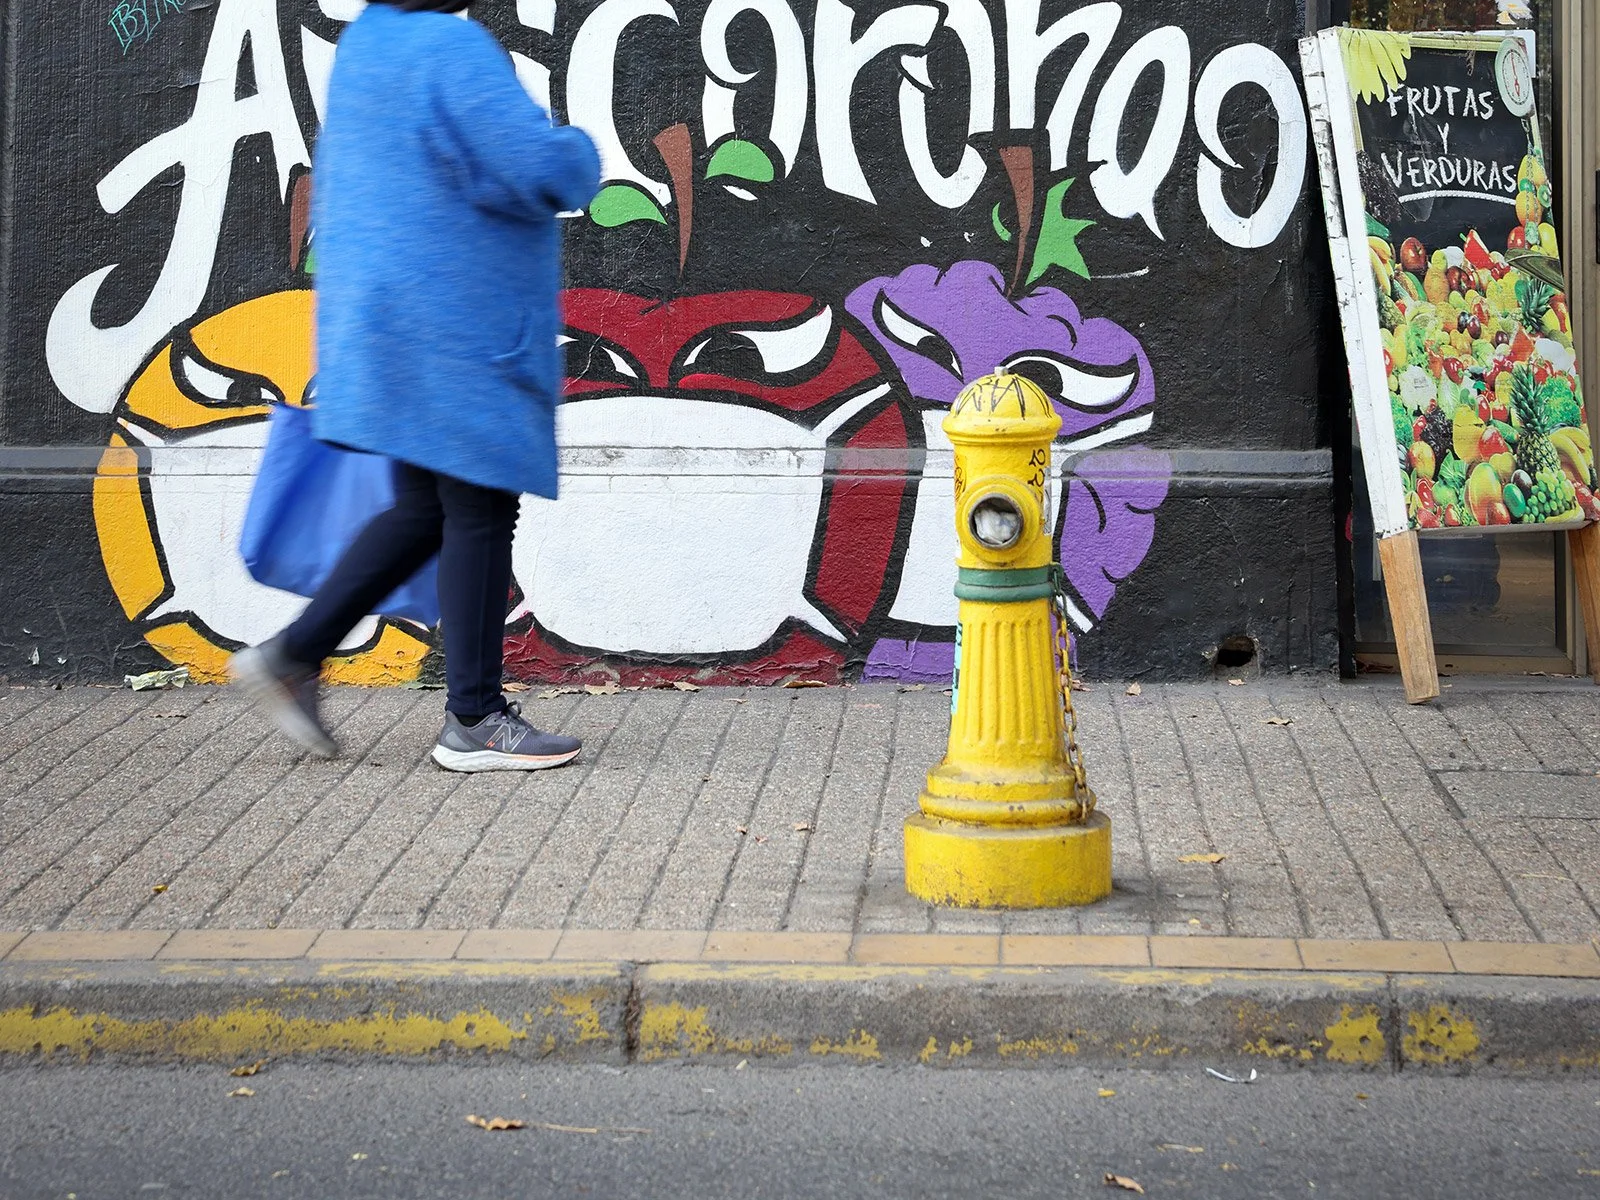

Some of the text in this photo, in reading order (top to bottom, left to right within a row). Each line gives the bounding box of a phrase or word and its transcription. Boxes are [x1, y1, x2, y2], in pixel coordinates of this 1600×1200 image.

[1386, 83, 1495, 120] FRUTAS
[1437, 122, 1450, 155] Y
[1381, 150, 1517, 194] VERDURAS
